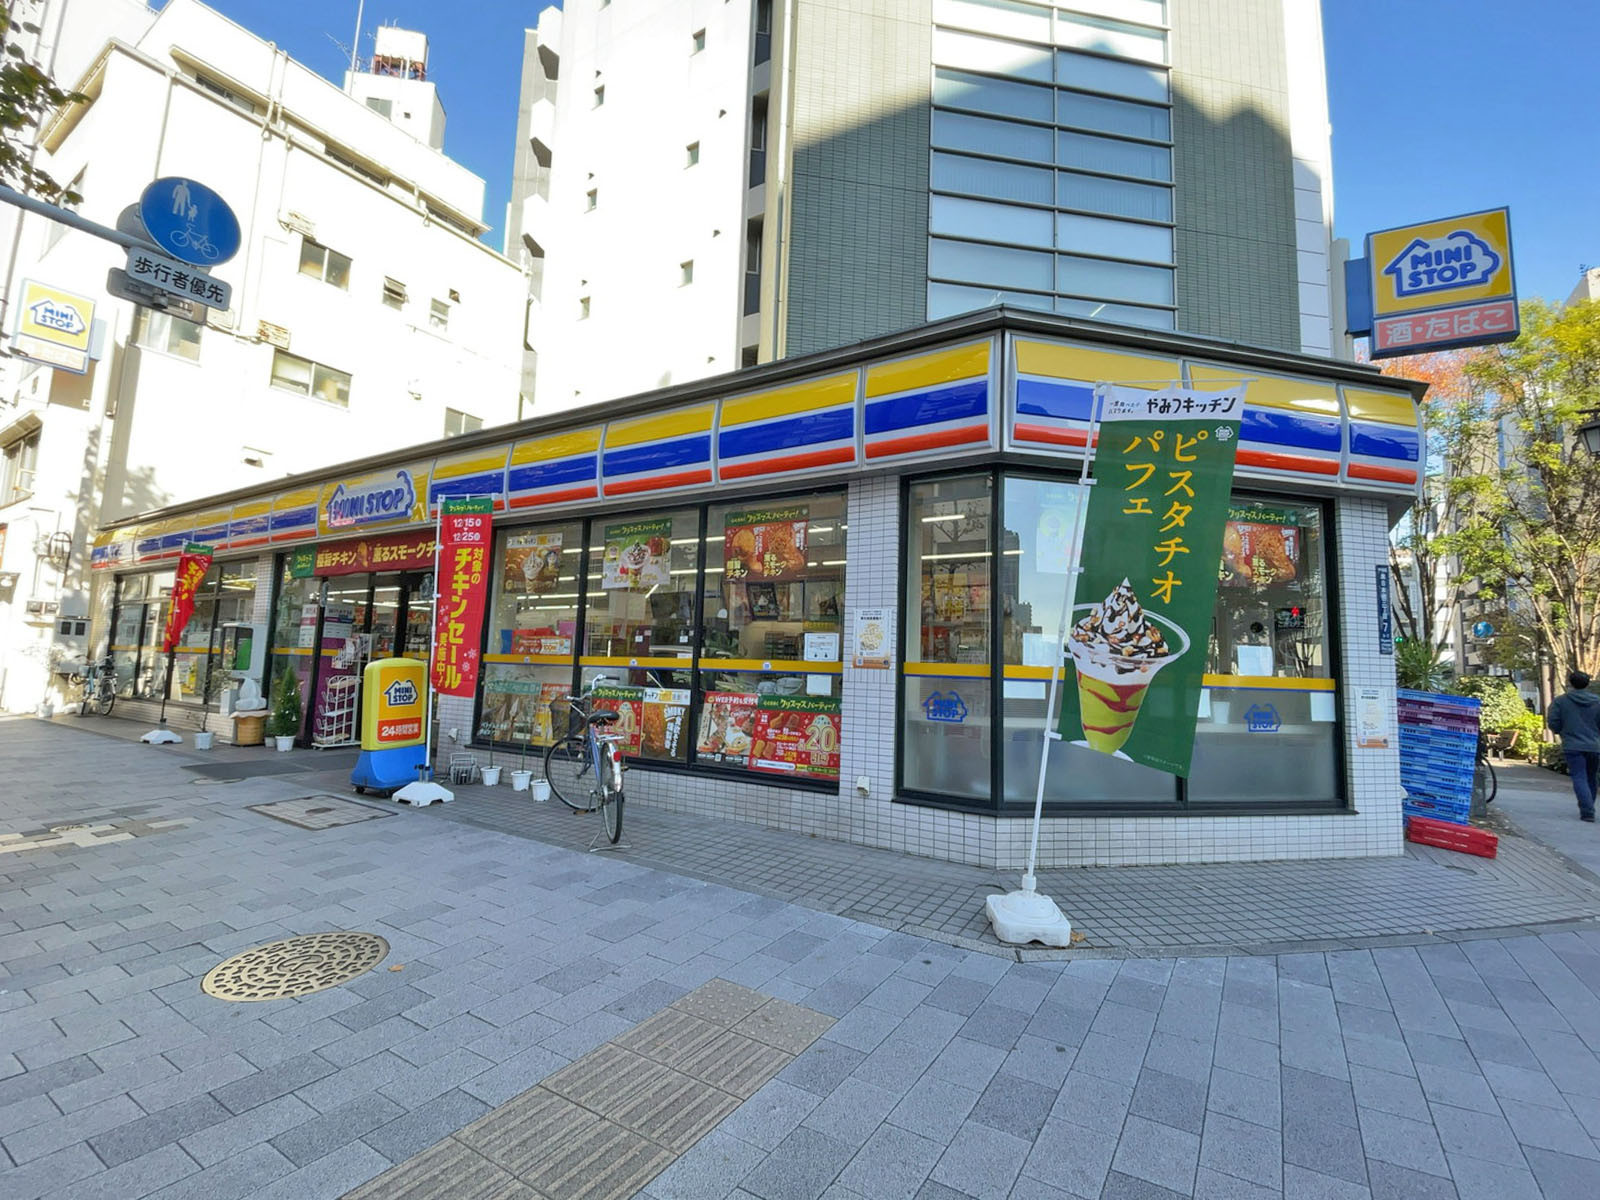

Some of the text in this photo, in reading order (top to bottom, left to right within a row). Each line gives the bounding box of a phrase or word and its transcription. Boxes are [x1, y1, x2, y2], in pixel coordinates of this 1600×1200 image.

[1411, 245, 1472, 270] MINI
[134, 256, 224, 304] 歩行者優先
[1408, 262, 1476, 288] STOP
[41, 314, 73, 329] STOP
[44, 306, 73, 321] MINI
[1386, 309, 1507, 345] 酒・たばこ
[1147, 398, 1236, 414] やみつキッチン
[1122, 430, 1164, 514] パフェ
[333, 488, 404, 520] MINI STOP
[1150, 430, 1209, 604] ピスタチオ
[471, 547, 484, 585] 対象の
[445, 547, 472, 690] チキンセール
[394, 687, 412, 695] MINI
[804, 726, 836, 752] 20
